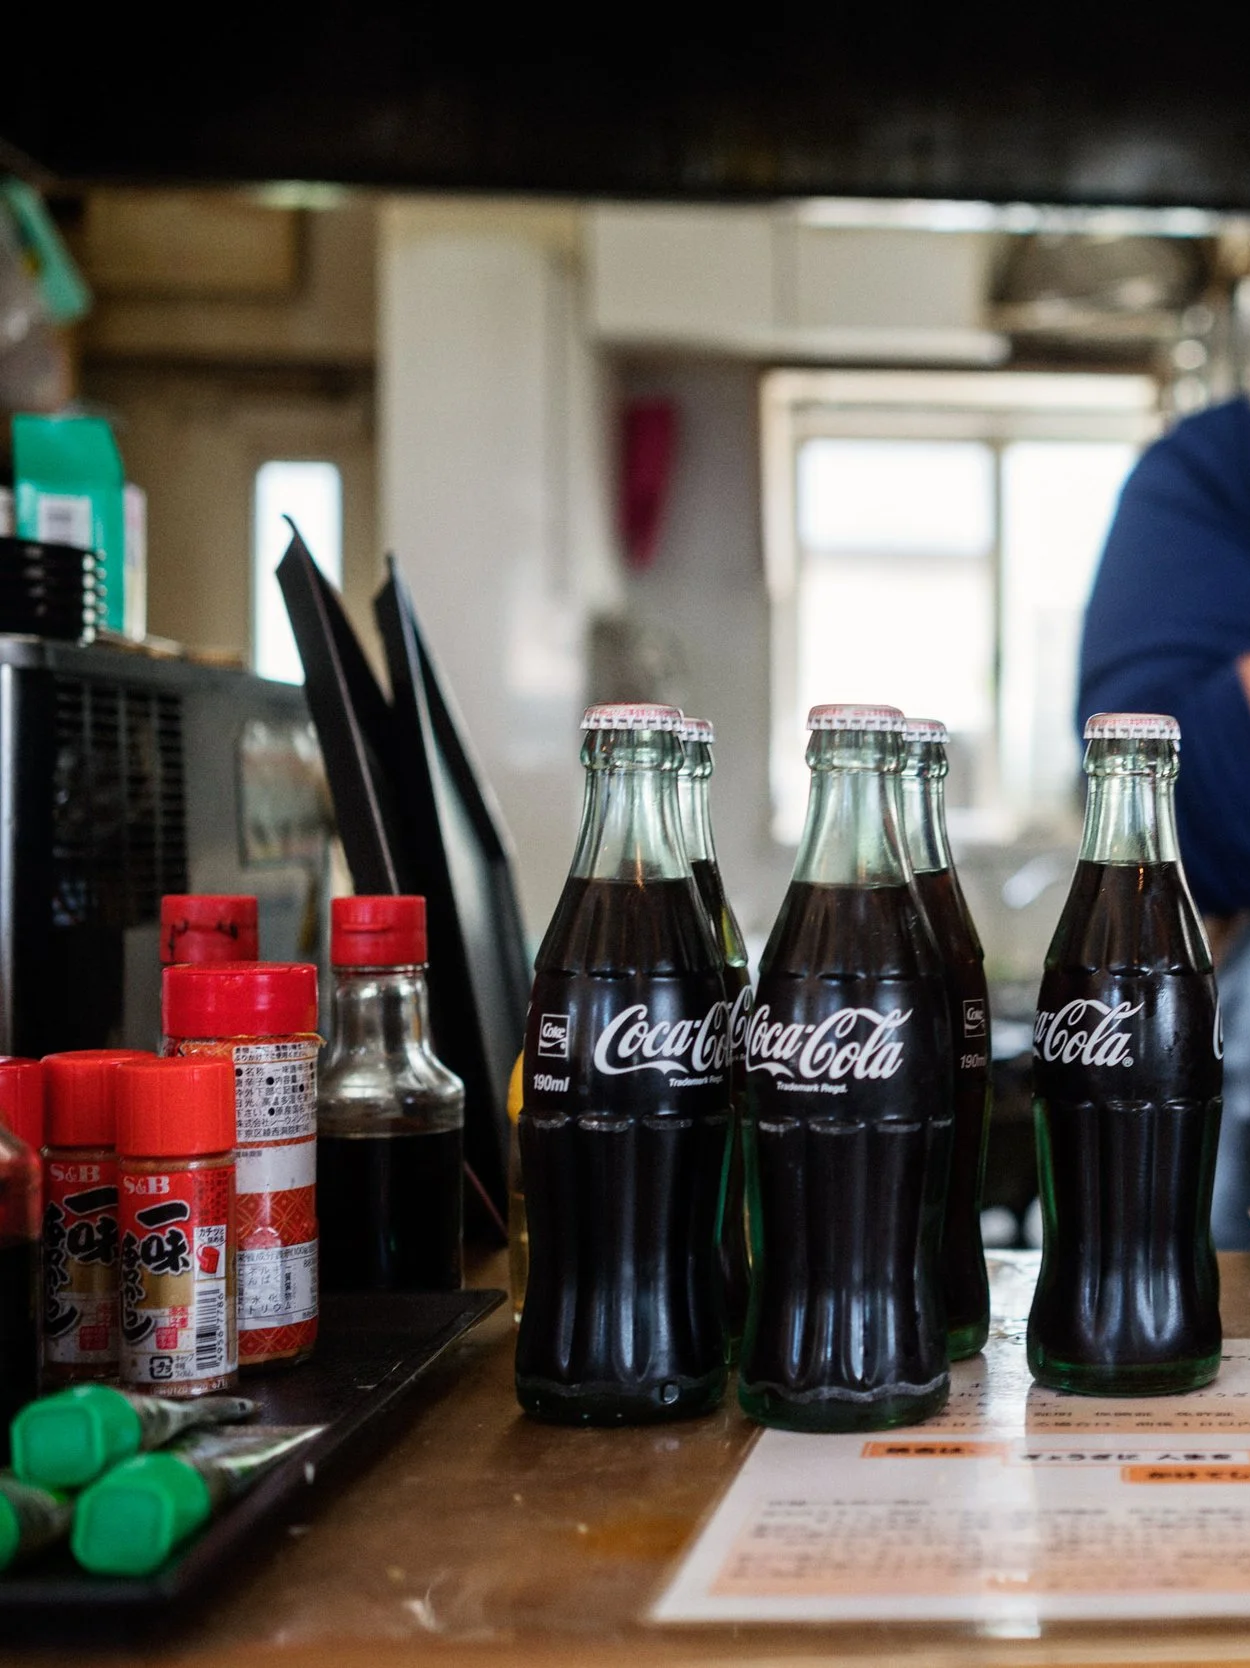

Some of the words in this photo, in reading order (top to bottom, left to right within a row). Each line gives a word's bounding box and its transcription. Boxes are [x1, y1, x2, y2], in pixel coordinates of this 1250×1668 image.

[543, 1022, 567, 1038] Coke
[594, 1001, 731, 1075] Coca-Co
[1034, 998, 1144, 1067] a-Cola
[746, 1004, 913, 1080] Coca-Cola
[960, 1053, 985, 1069] 190m
[533, 1074, 570, 1092] 190ml
[776, 1081, 820, 1093] Trademark
[49, 1164, 101, 1183] S&B
[123, 1175, 170, 1194] S&B
[135, 1199, 192, 1275] 一味
